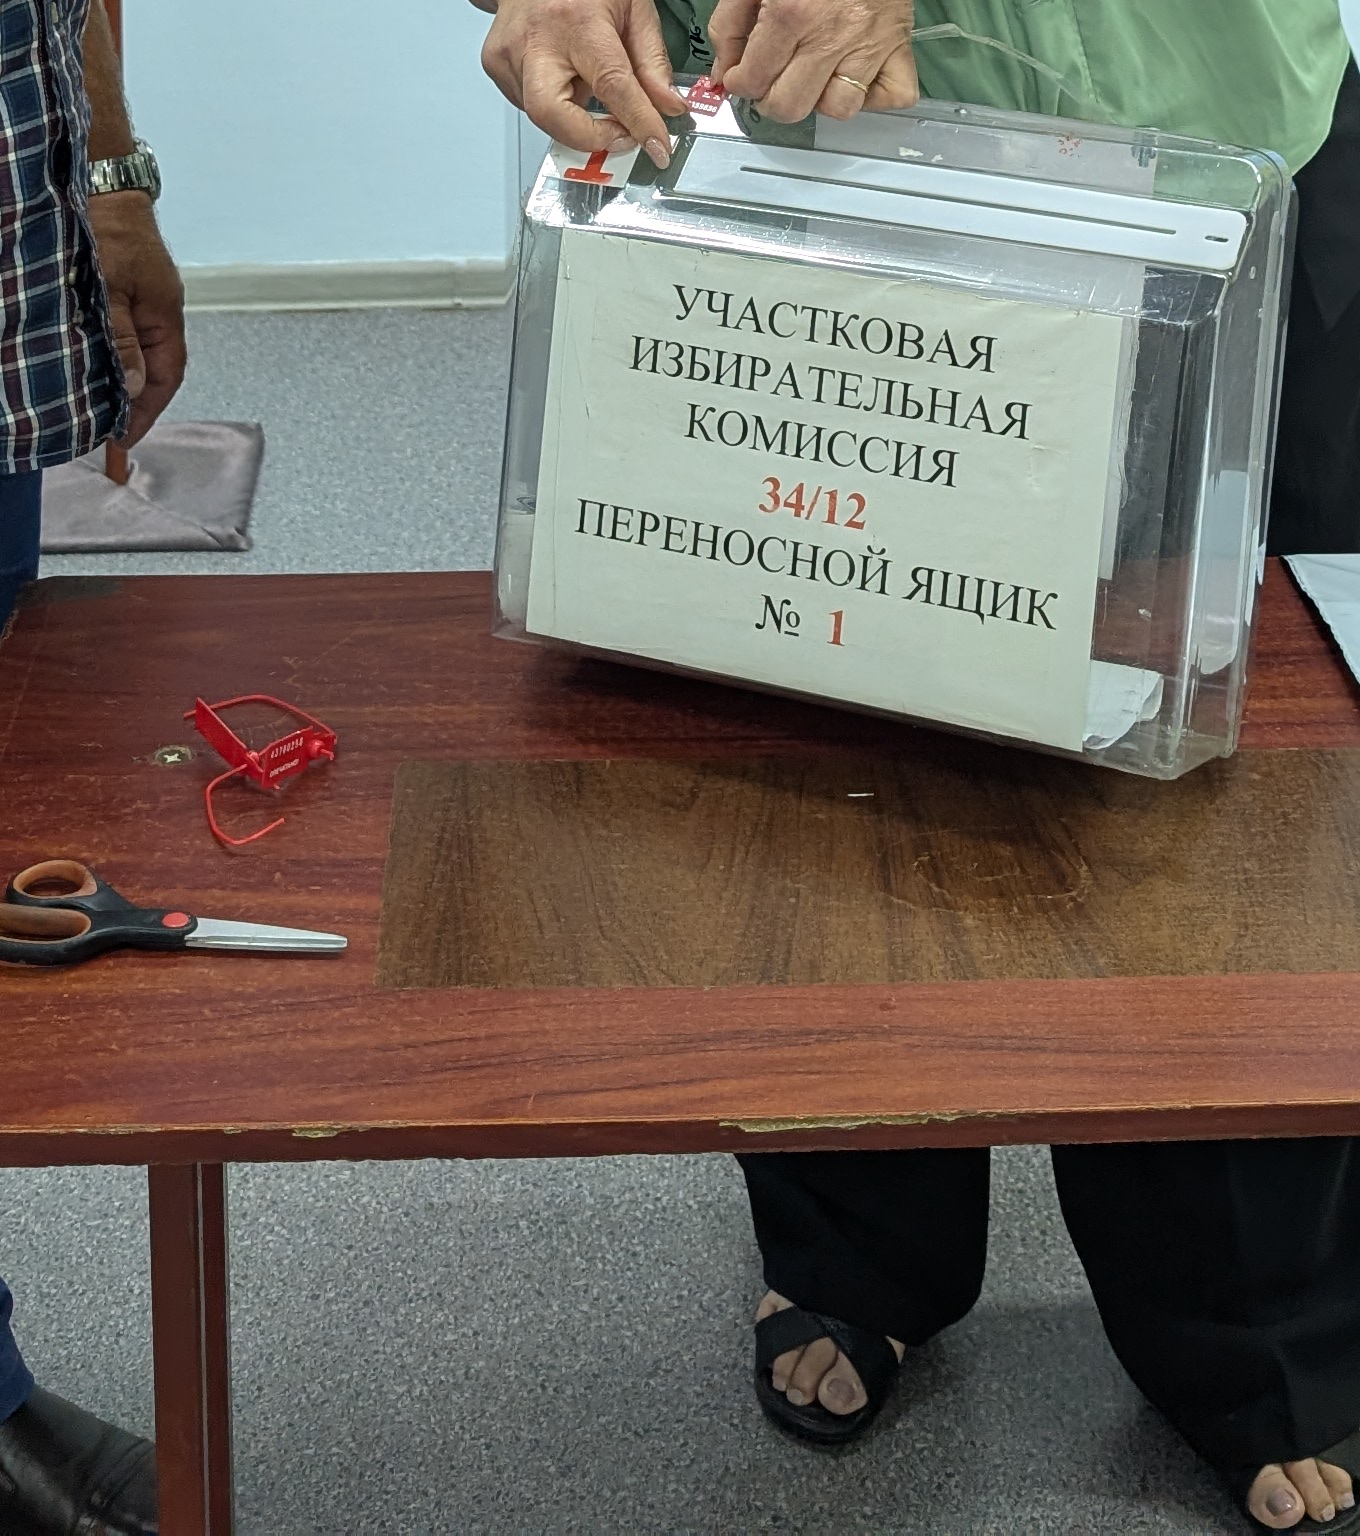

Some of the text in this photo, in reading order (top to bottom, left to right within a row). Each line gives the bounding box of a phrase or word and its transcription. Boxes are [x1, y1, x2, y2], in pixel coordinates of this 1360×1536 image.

[673, 284, 998, 373] УЧАСТКОВАЯ
[630, 335, 1032, 440] ИЗБИРАТЕЛЬНАЯ
[685, 403, 960, 488] КОМИССИЯ
[758, 476, 867, 530] 34/12
[574, 497, 1059, 629] ПЕРЕНОСНОЙ ЯЩИК
[756, 595, 847, 647] № 1
